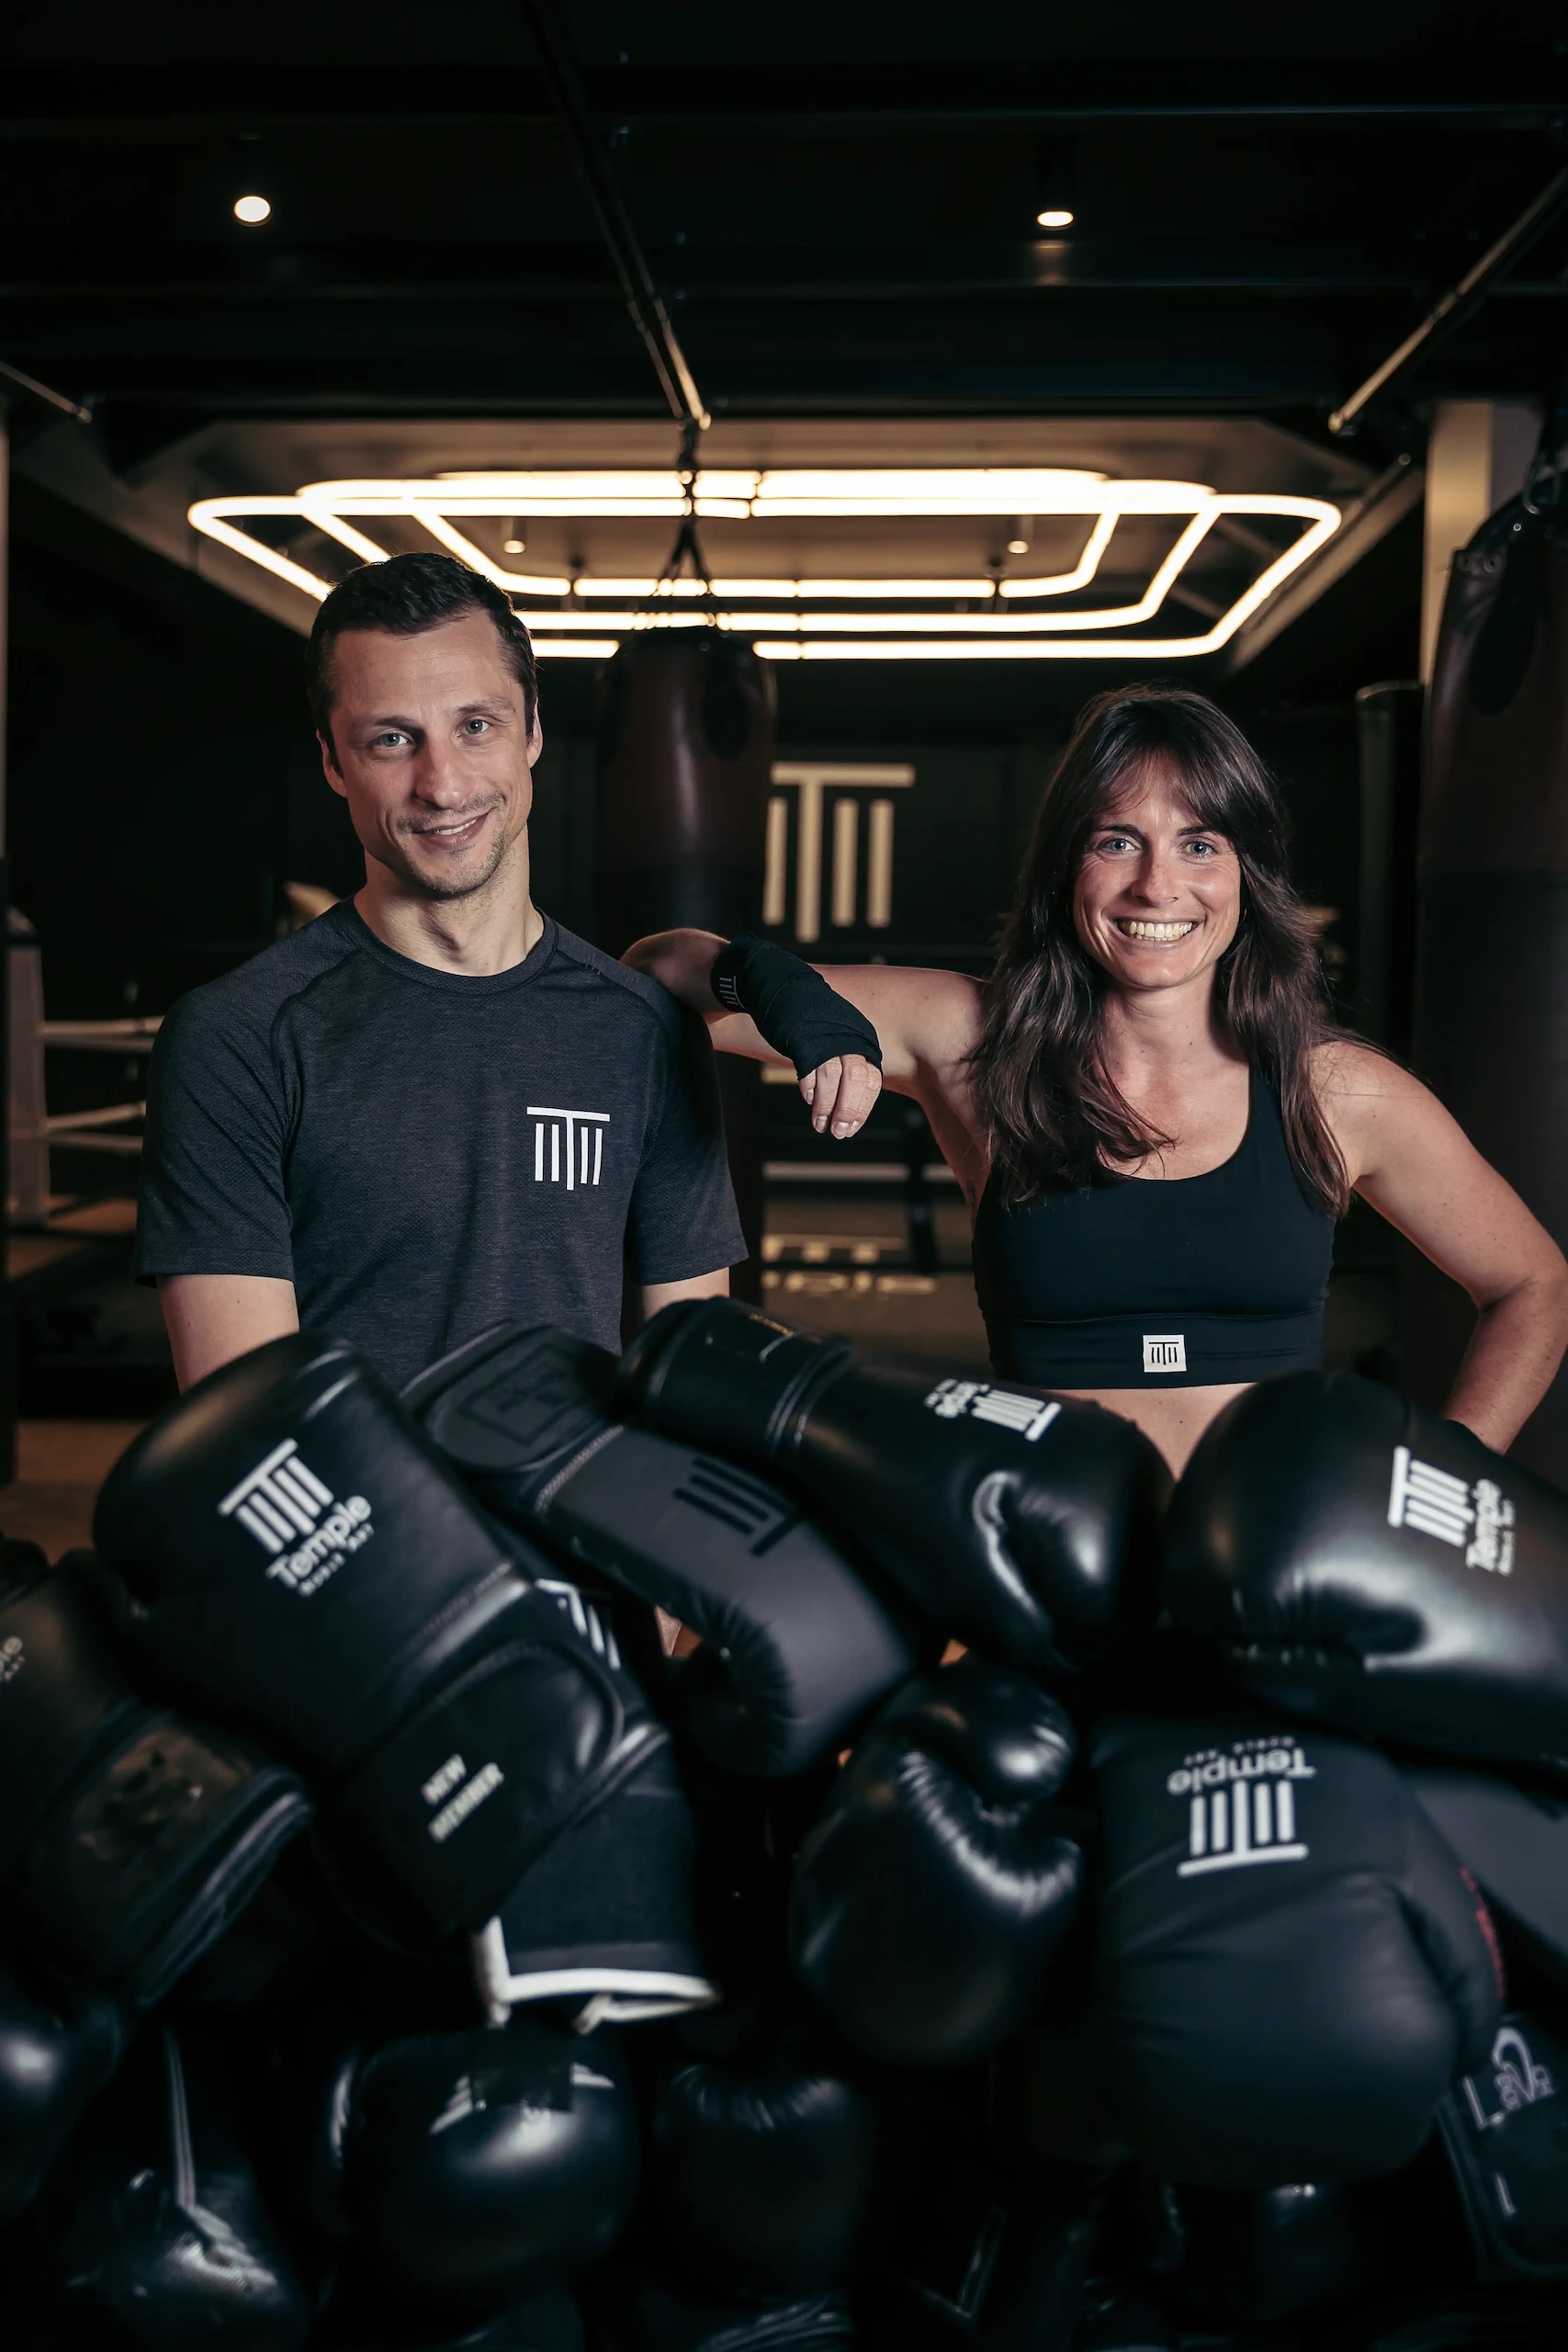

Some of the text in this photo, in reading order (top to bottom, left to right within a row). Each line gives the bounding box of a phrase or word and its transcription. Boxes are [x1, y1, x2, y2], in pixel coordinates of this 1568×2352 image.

[265, 1496, 372, 1589] Temple
[1465, 1478, 1502, 1573] Temple
[1167, 1746, 1317, 1796] Temple
